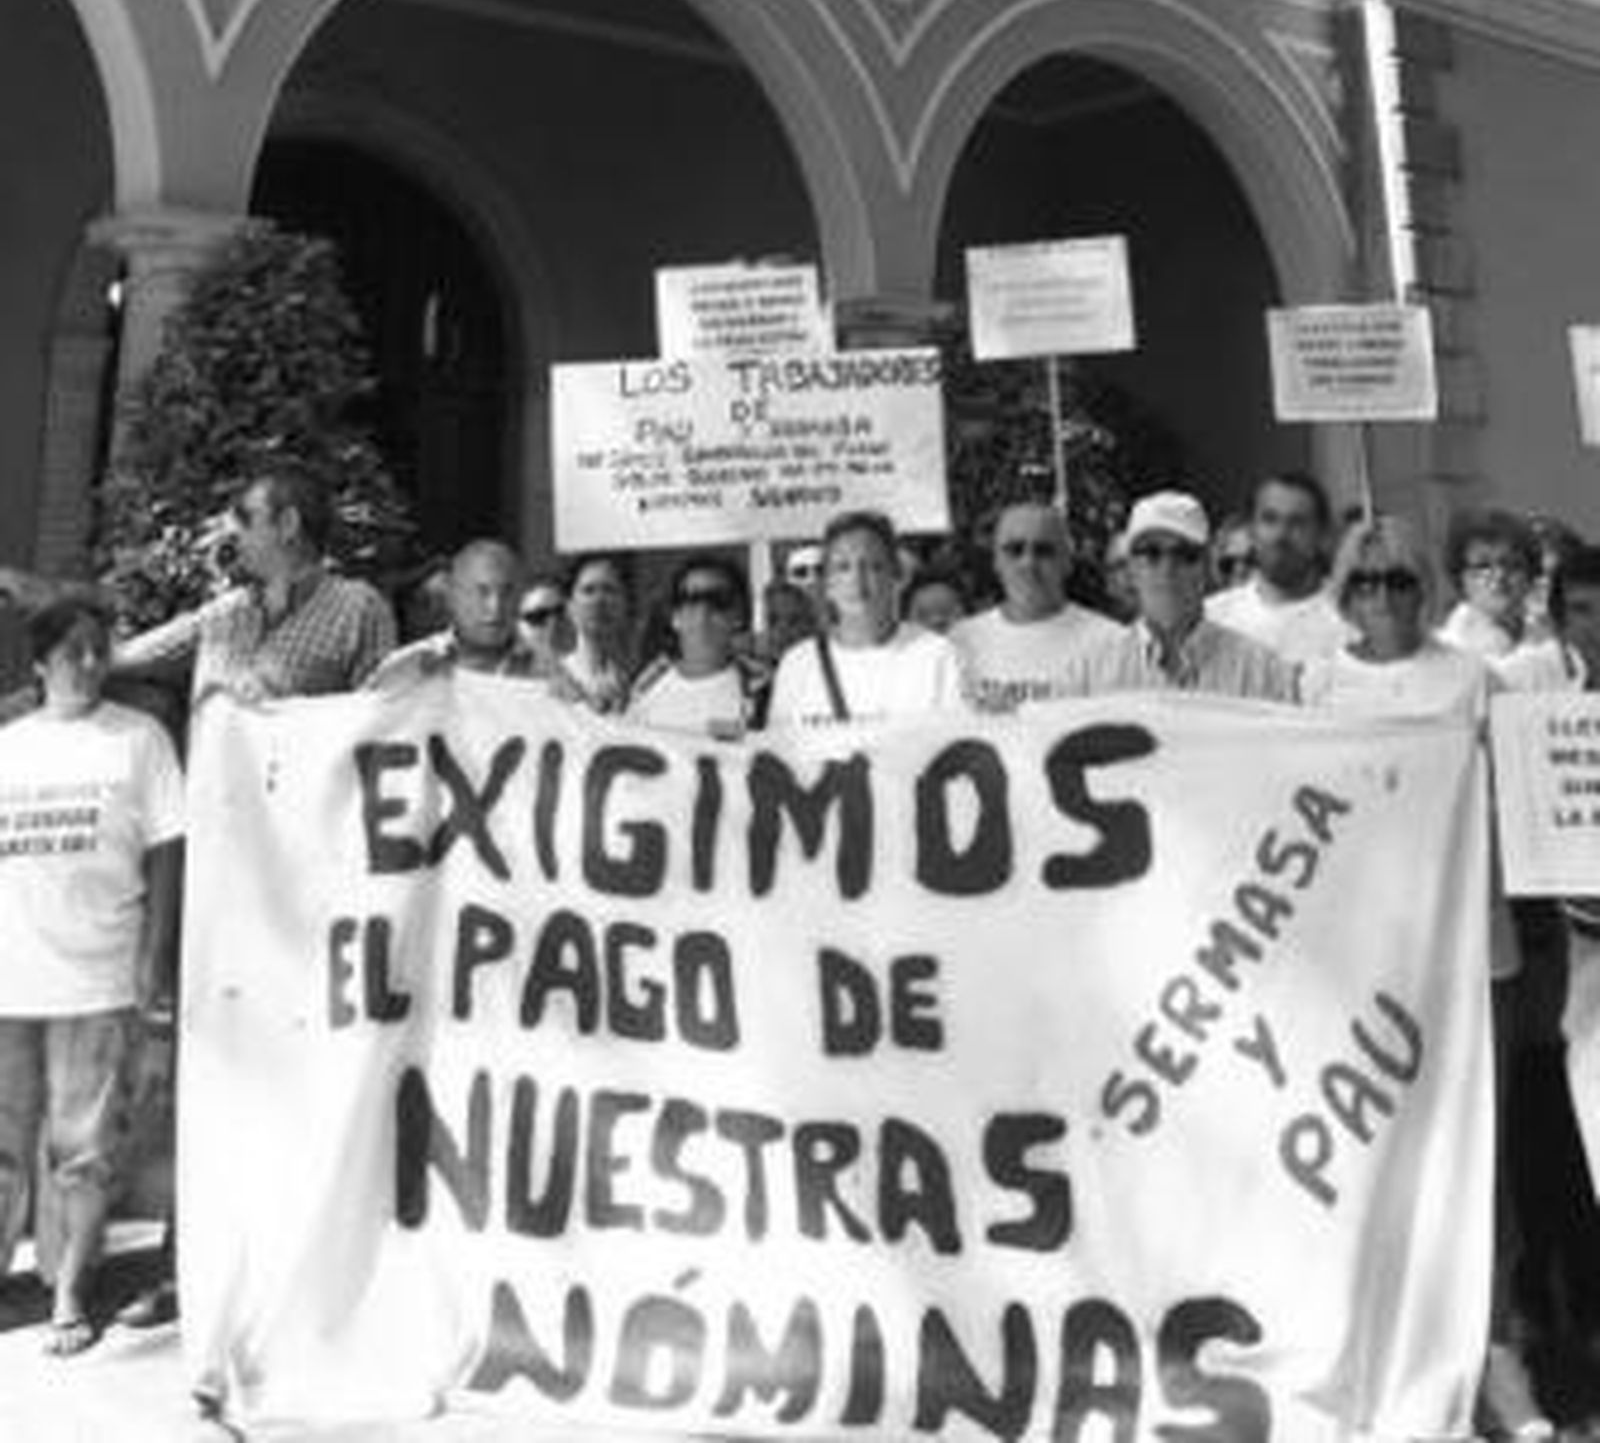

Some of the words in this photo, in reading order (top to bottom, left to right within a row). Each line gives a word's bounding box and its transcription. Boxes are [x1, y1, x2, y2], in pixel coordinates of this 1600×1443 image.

[620, 360, 692, 398] LOS
[730, 399, 770, 422] DE
[353, 722, 1160, 901] EXIGIMOS
[328, 915, 416, 1030] EL
[451, 902, 741, 1051] PAGO
[816, 946, 946, 1059] DE
[1098, 784, 1352, 1136] SERMASA
[1234, 1014, 1288, 1089] Y
[1278, 991, 1426, 1206] PAU
[393, 1063, 1075, 1258] NUESTRAS
[466, 1268, 1274, 1443] NÓMINAS
